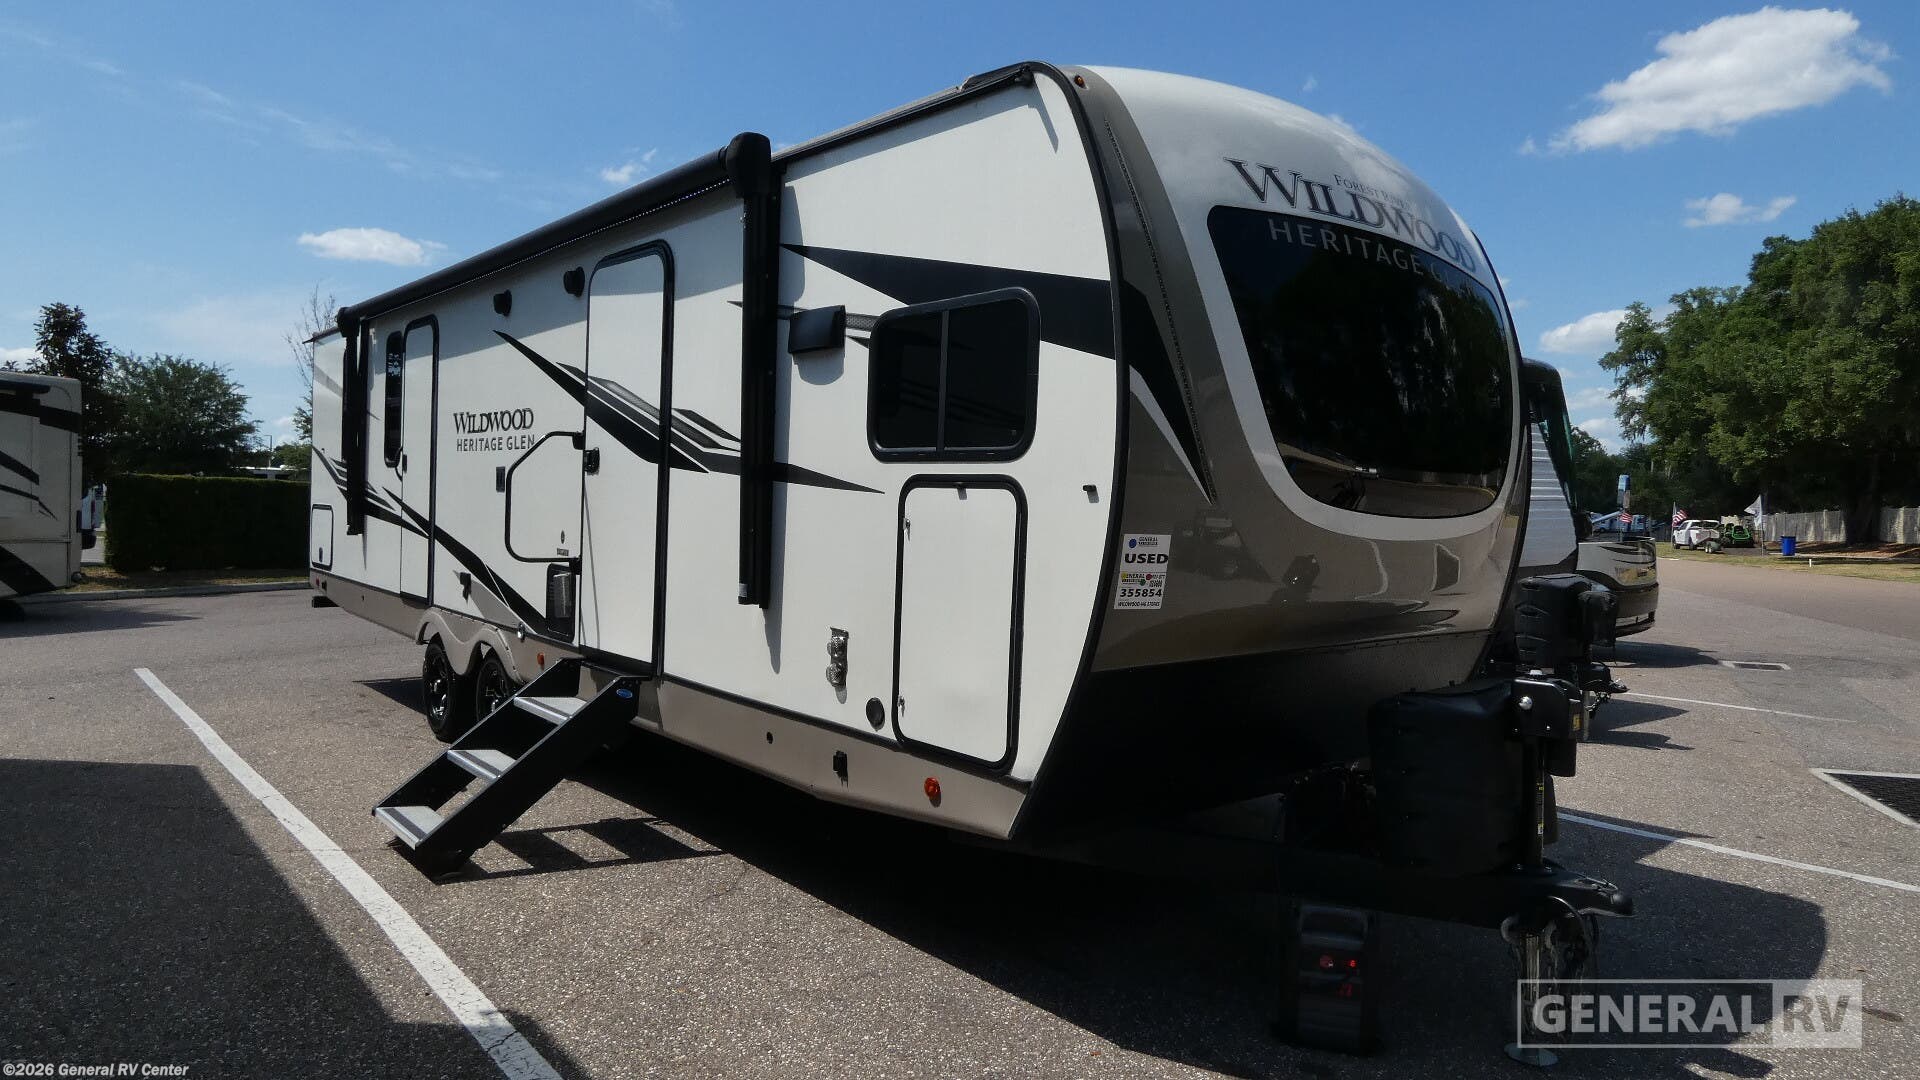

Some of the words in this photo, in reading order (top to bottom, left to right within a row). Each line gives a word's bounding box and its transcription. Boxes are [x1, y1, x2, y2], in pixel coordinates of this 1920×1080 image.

[1223, 157, 1477, 274] WILDWOOD
[1267, 218, 1425, 275] HERITAGE
[453, 408, 534, 434] WILDWOOD
[456, 436, 503, 452] HERITAGE
[506, 434, 535, 450] GLEN
[1124, 553, 1169, 564] USED
[1120, 588, 1162, 598] 355854
